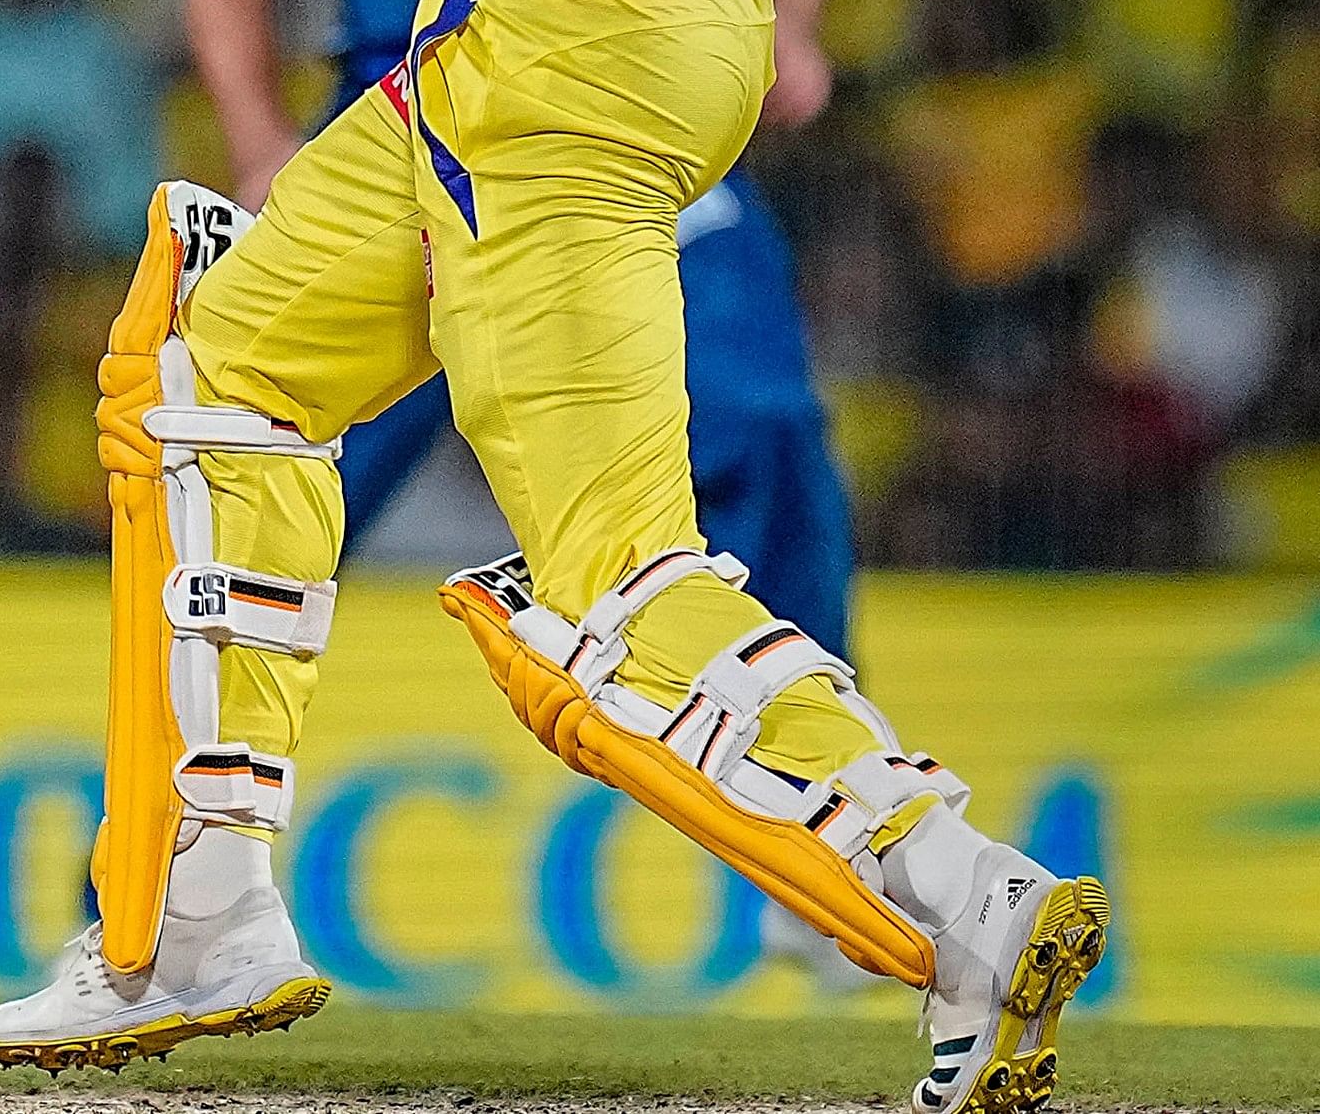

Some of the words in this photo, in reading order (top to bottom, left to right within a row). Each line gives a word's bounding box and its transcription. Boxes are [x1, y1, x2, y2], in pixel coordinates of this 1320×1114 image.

[183, 203, 233, 273] SS
[188, 572, 226, 617] SS
[1008, 878, 1037, 910] adidas
